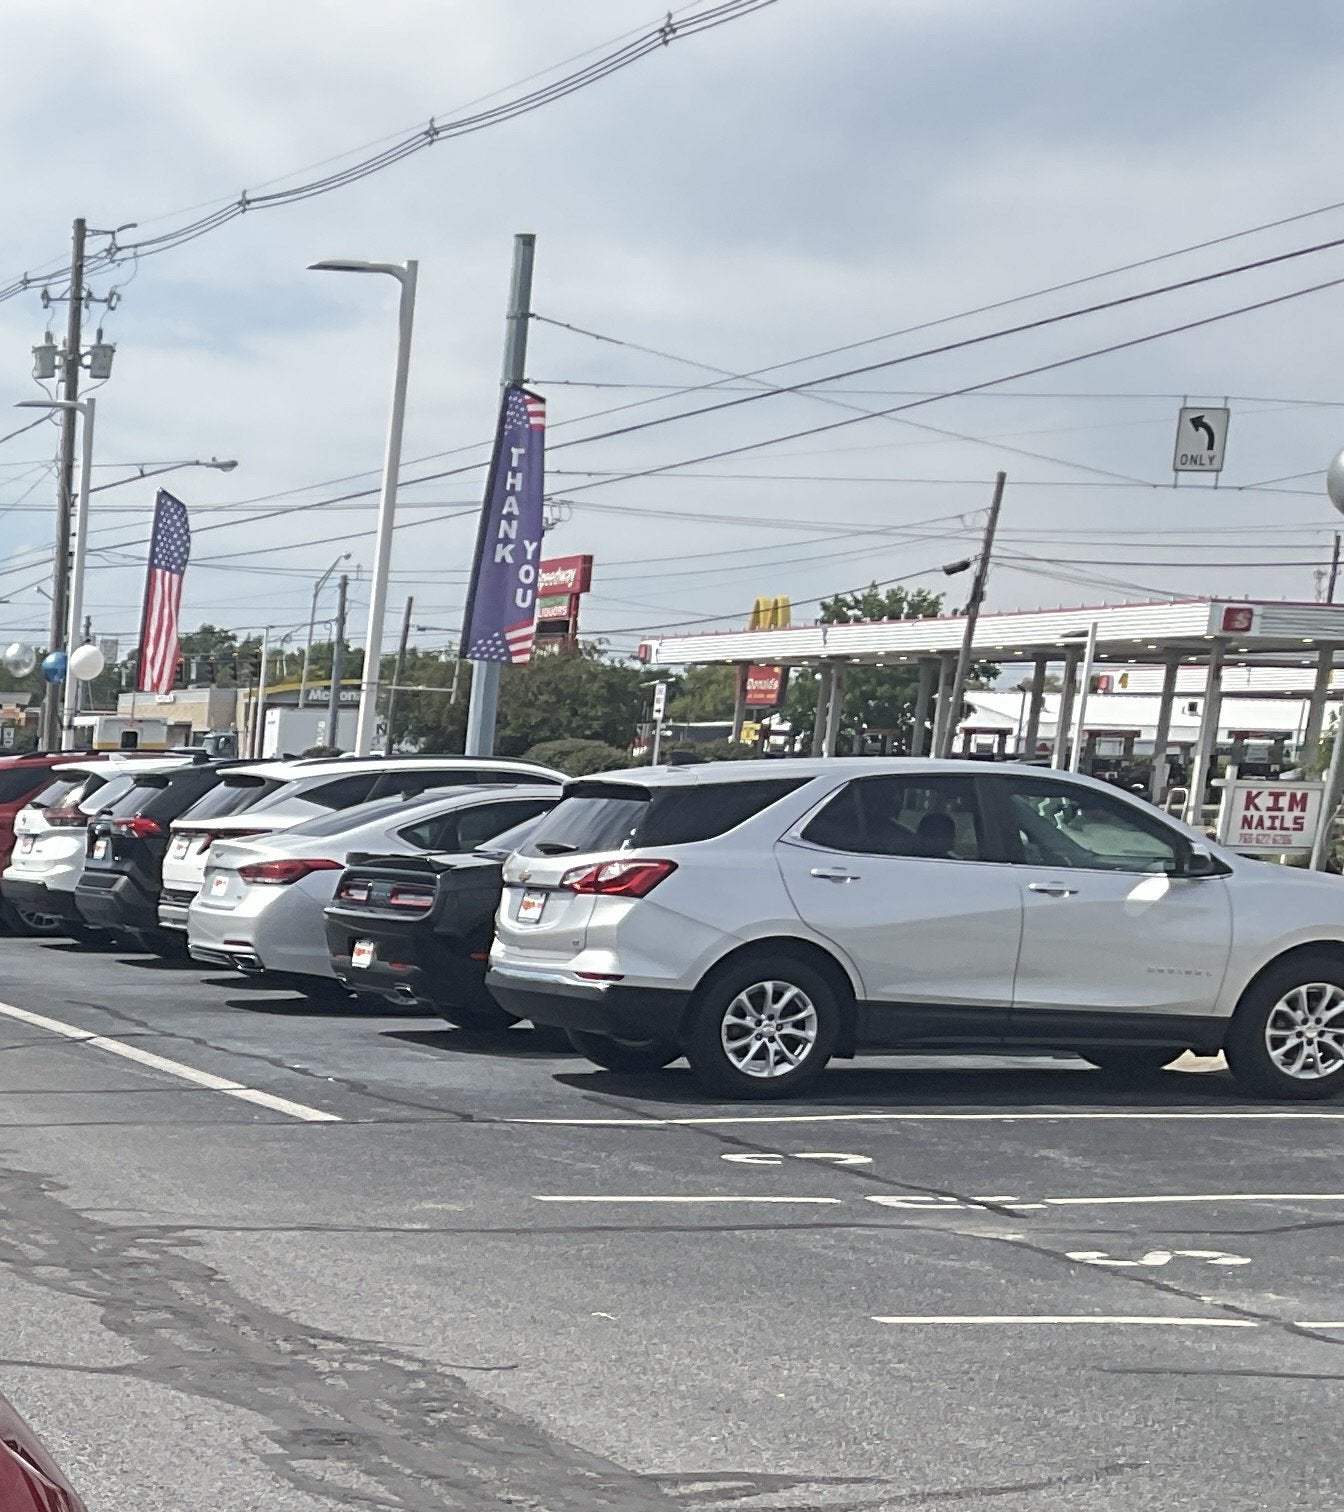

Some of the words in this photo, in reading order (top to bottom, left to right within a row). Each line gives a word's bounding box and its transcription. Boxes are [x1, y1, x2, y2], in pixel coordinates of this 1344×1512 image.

[1179, 453, 1217, 466] ONLY
[494, 446, 526, 564] THANK
[515, 539, 538, 609] YOU
[1243, 790, 1309, 813] KIM
[1240, 814, 1305, 832] NAILS
